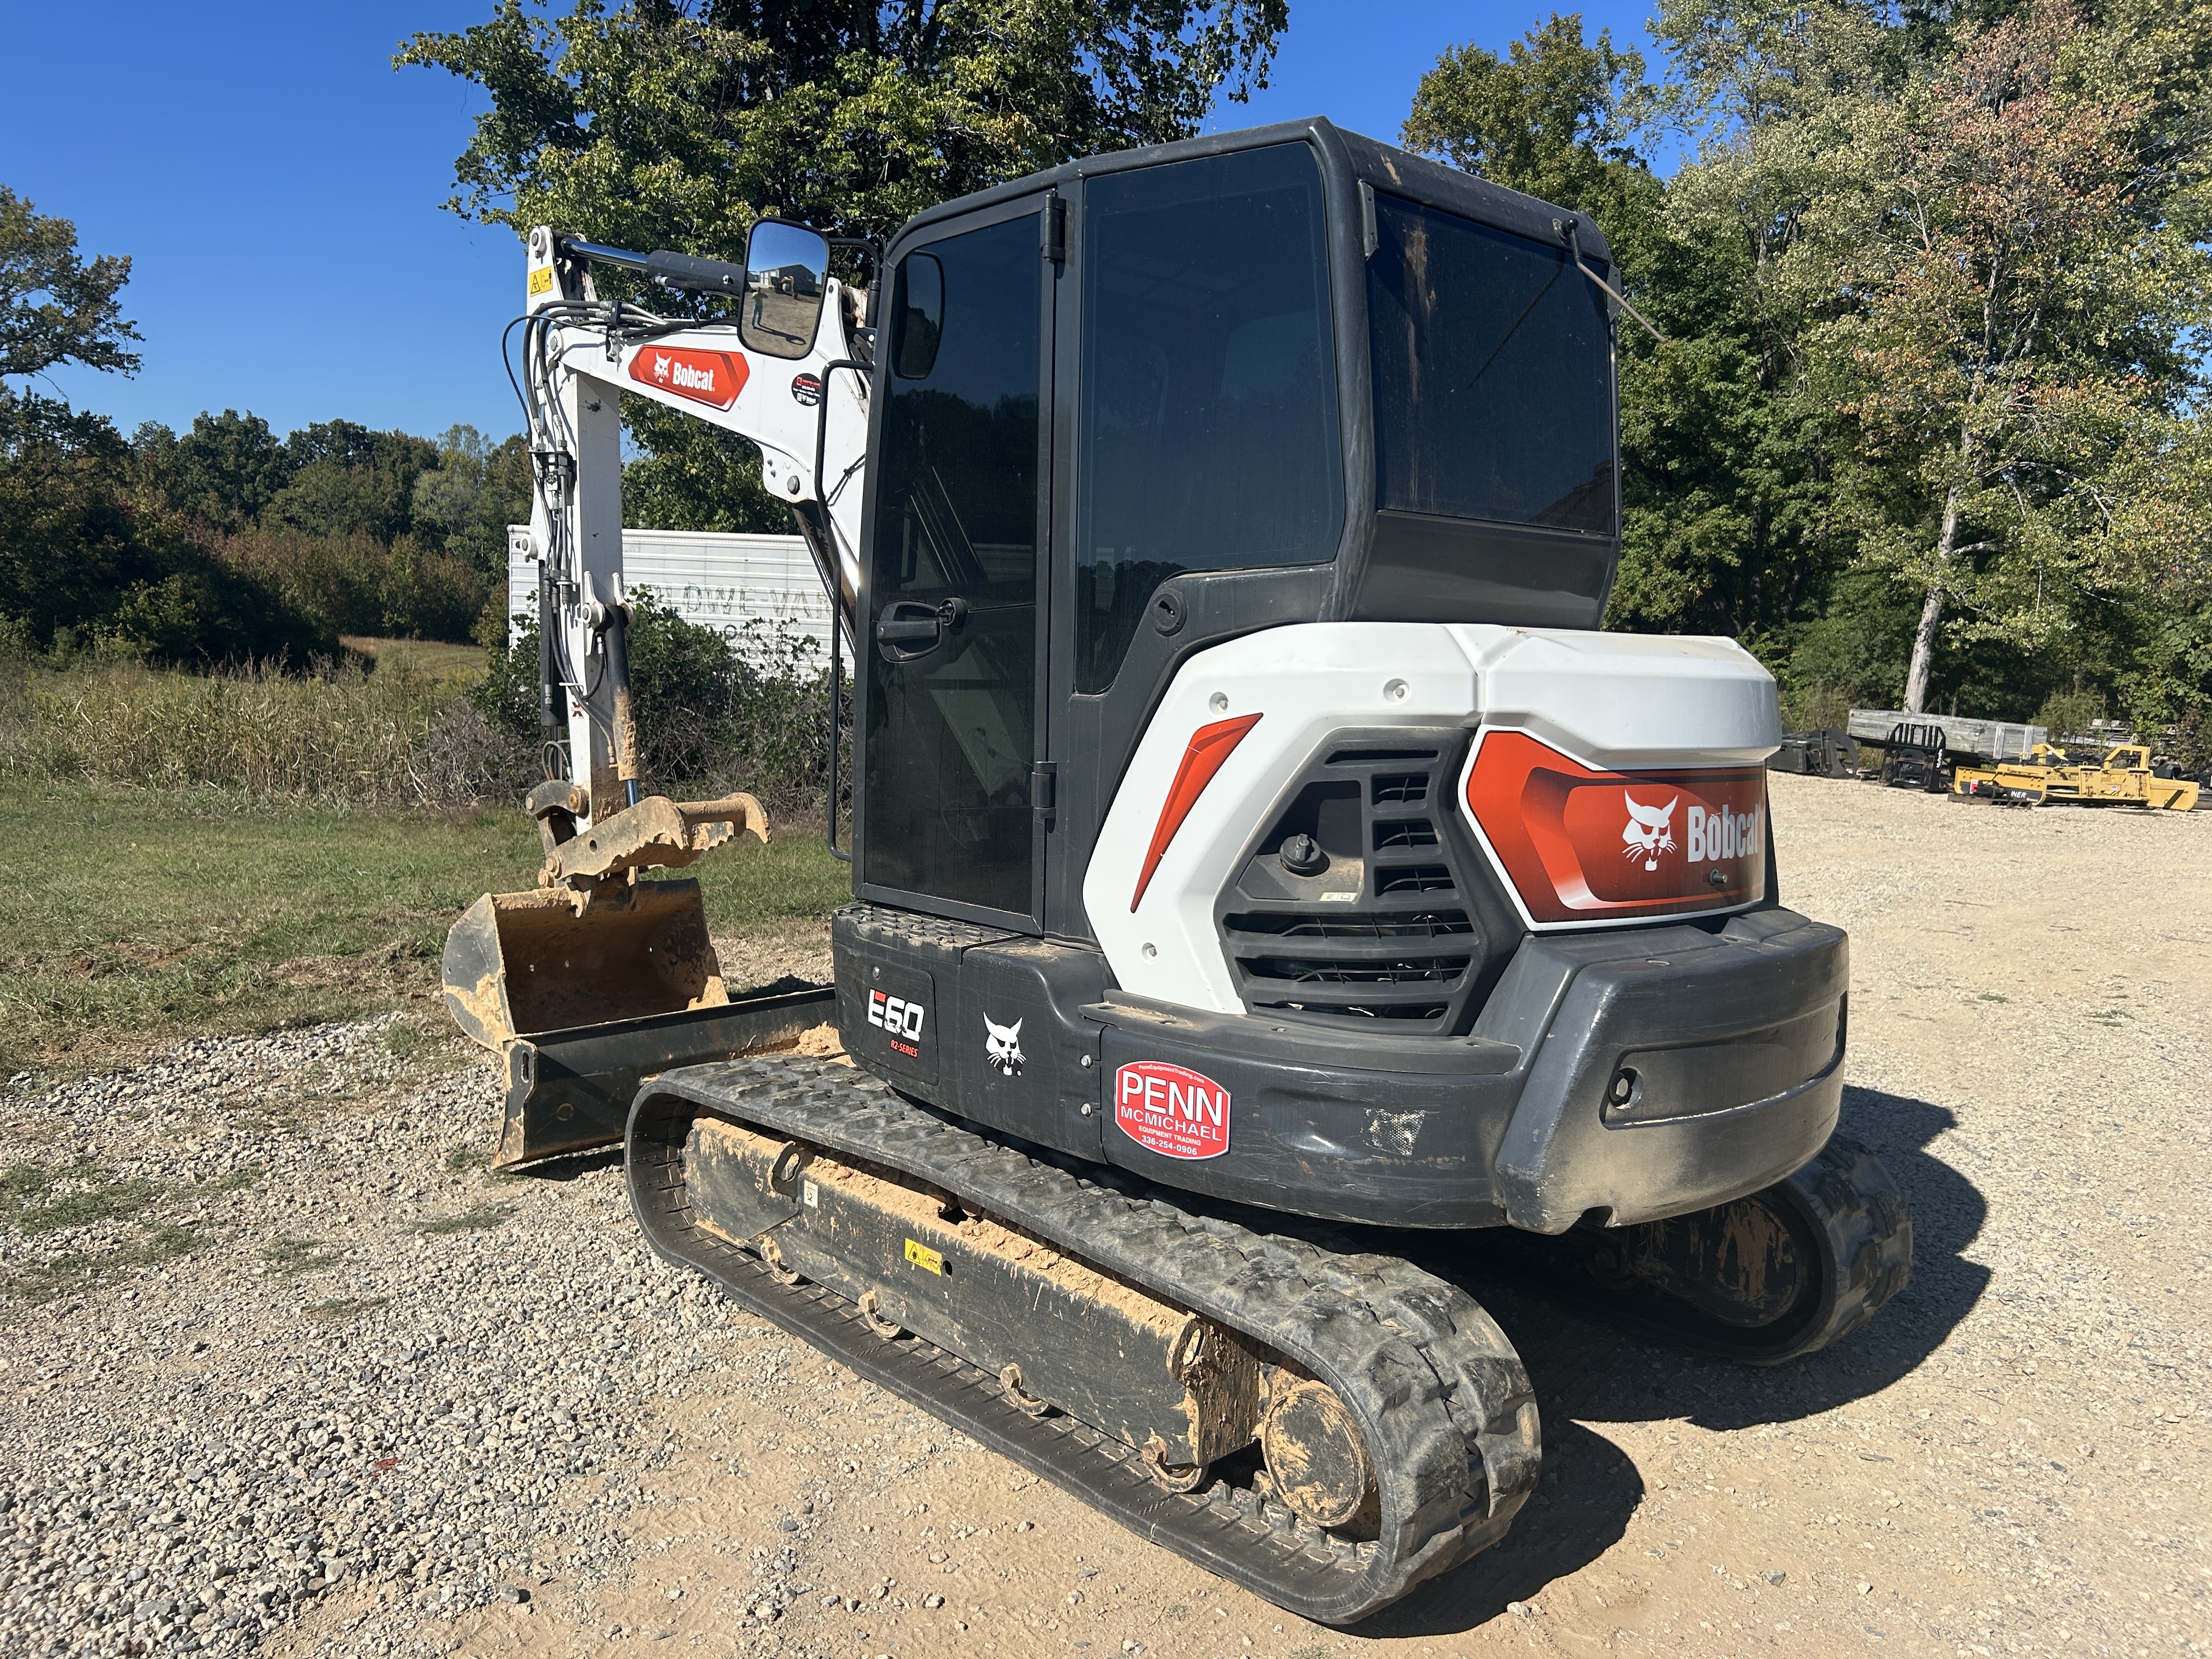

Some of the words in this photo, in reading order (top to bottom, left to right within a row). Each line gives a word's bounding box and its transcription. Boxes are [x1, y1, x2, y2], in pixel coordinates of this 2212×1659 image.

[673, 362, 714, 392] Bobcat
[1688, 804, 1758, 862] Bobcat
[868, 989, 924, 1042] E60
[890, 1039, 919, 1058] R2-SERIES
[1122, 1070, 1223, 1127] PENN
[1121, 1105, 1222, 1142] MCMICHAEL
[1138, 1125, 1172, 1139] EQUIPMENT
[1173, 1134, 1201, 1146] TRADING
[1142, 1135, 1198, 1156] 336-254-0906
